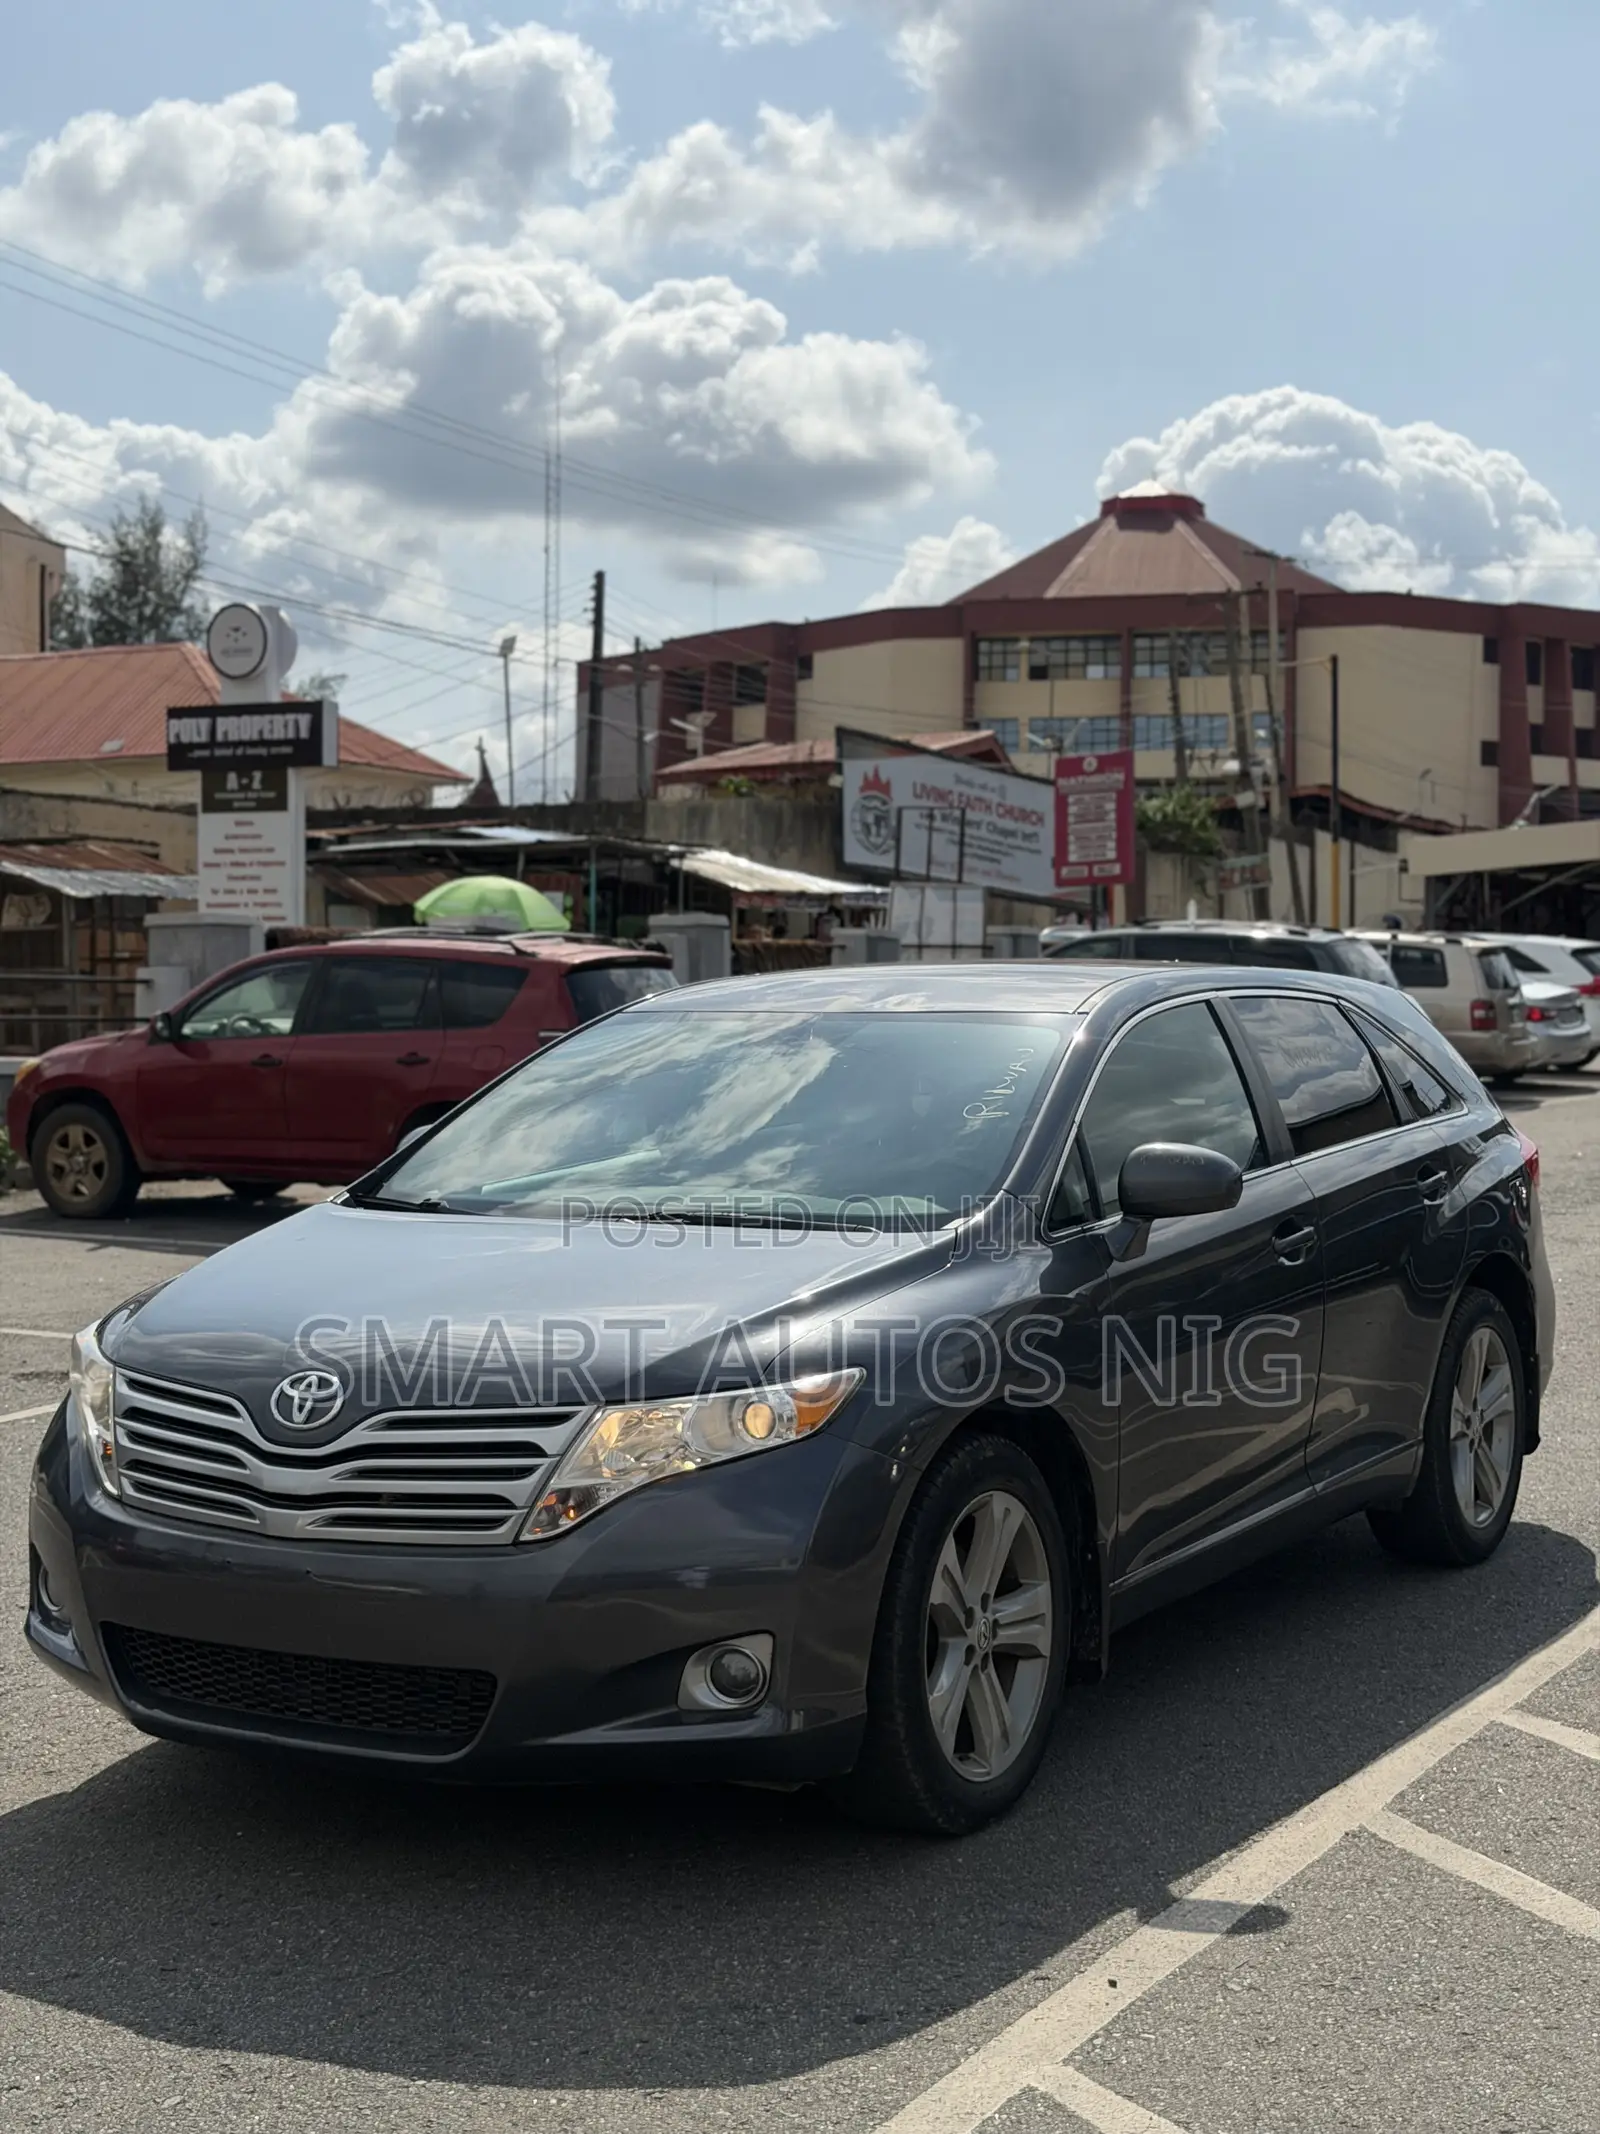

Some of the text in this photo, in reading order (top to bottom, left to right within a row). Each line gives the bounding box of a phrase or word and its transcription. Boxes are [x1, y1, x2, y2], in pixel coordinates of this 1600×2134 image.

[168, 713, 313, 744] POLY PROPERTY
[226, 771, 239, 791] A
[912, 781, 953, 808] LIVING
[957, 791, 993, 815] FAITH
[996, 802, 1044, 828] CHURCH
